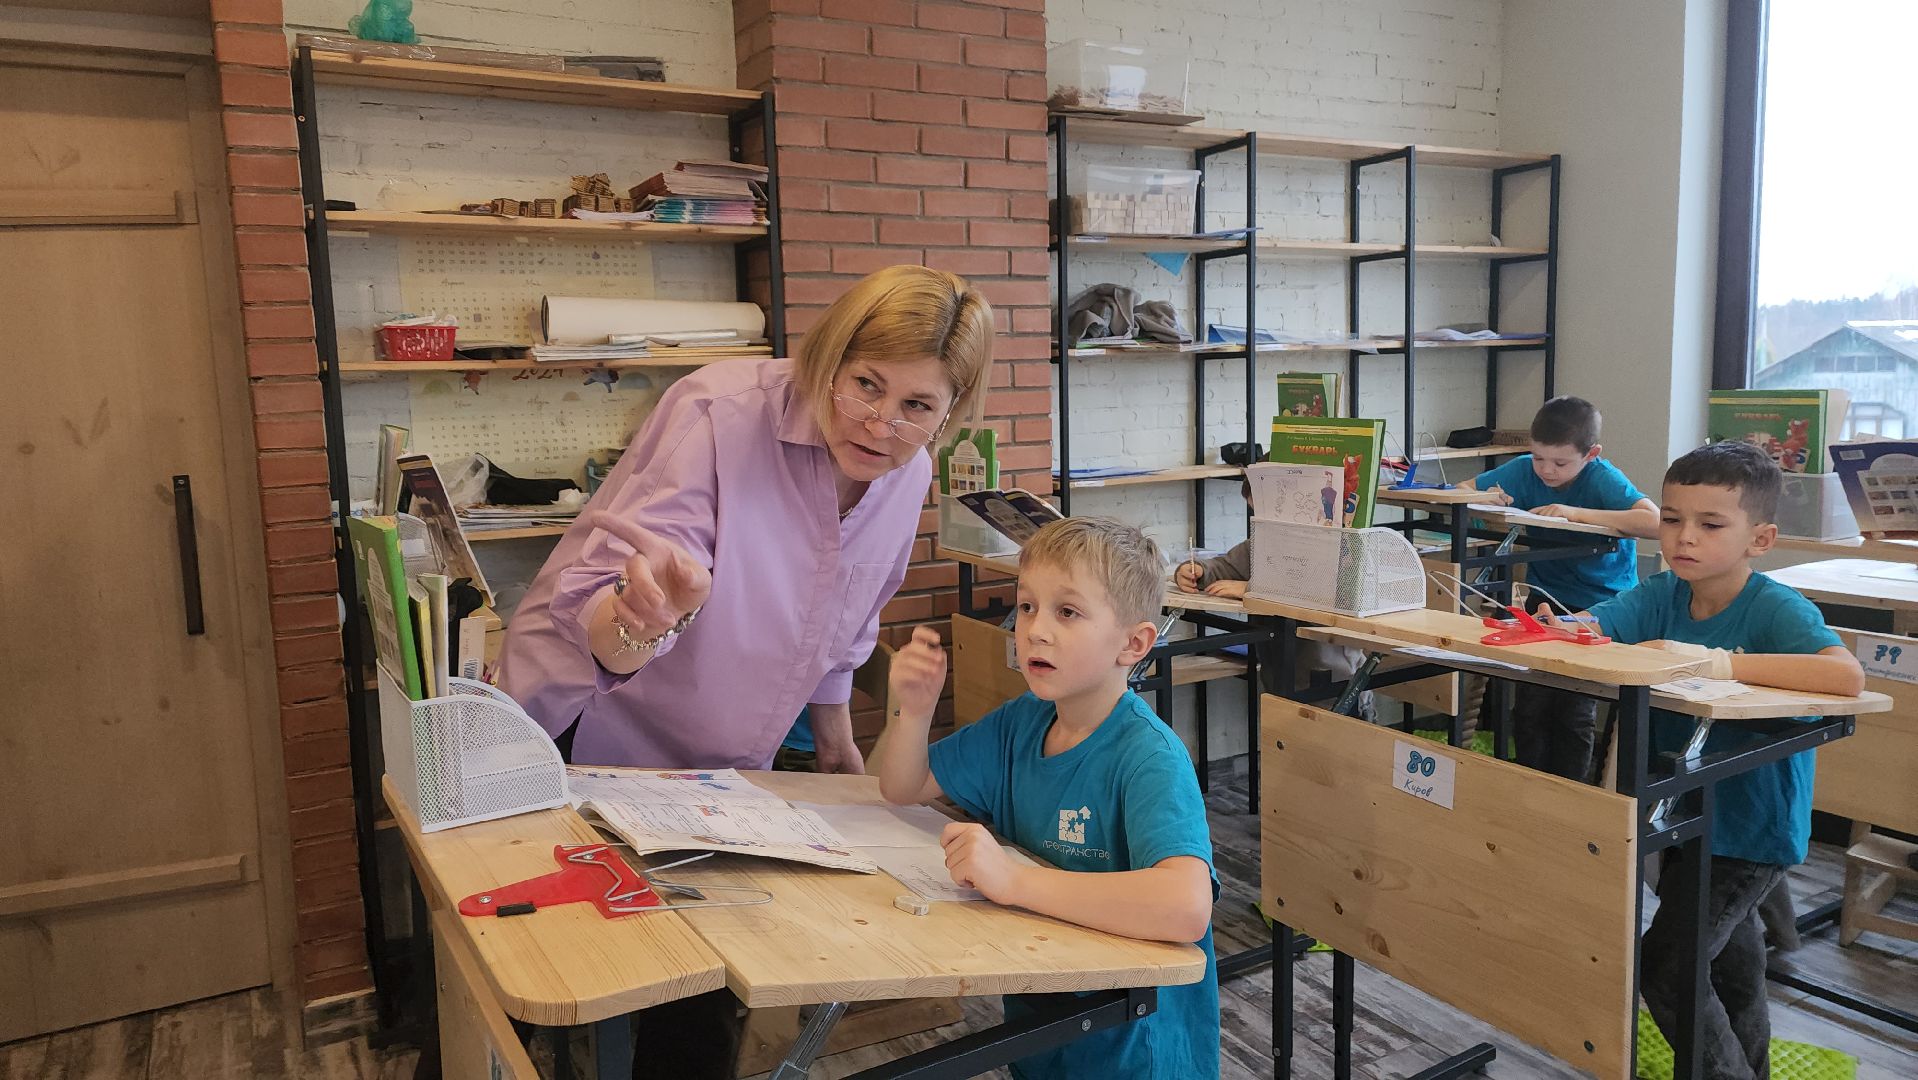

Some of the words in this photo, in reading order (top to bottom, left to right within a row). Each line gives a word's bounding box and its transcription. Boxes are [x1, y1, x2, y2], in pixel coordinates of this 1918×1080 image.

[1292, 443, 1338, 456] БУКВАРЬ
[1406, 750, 1436, 777] 80
[1403, 778, 1434, 798] Киров
